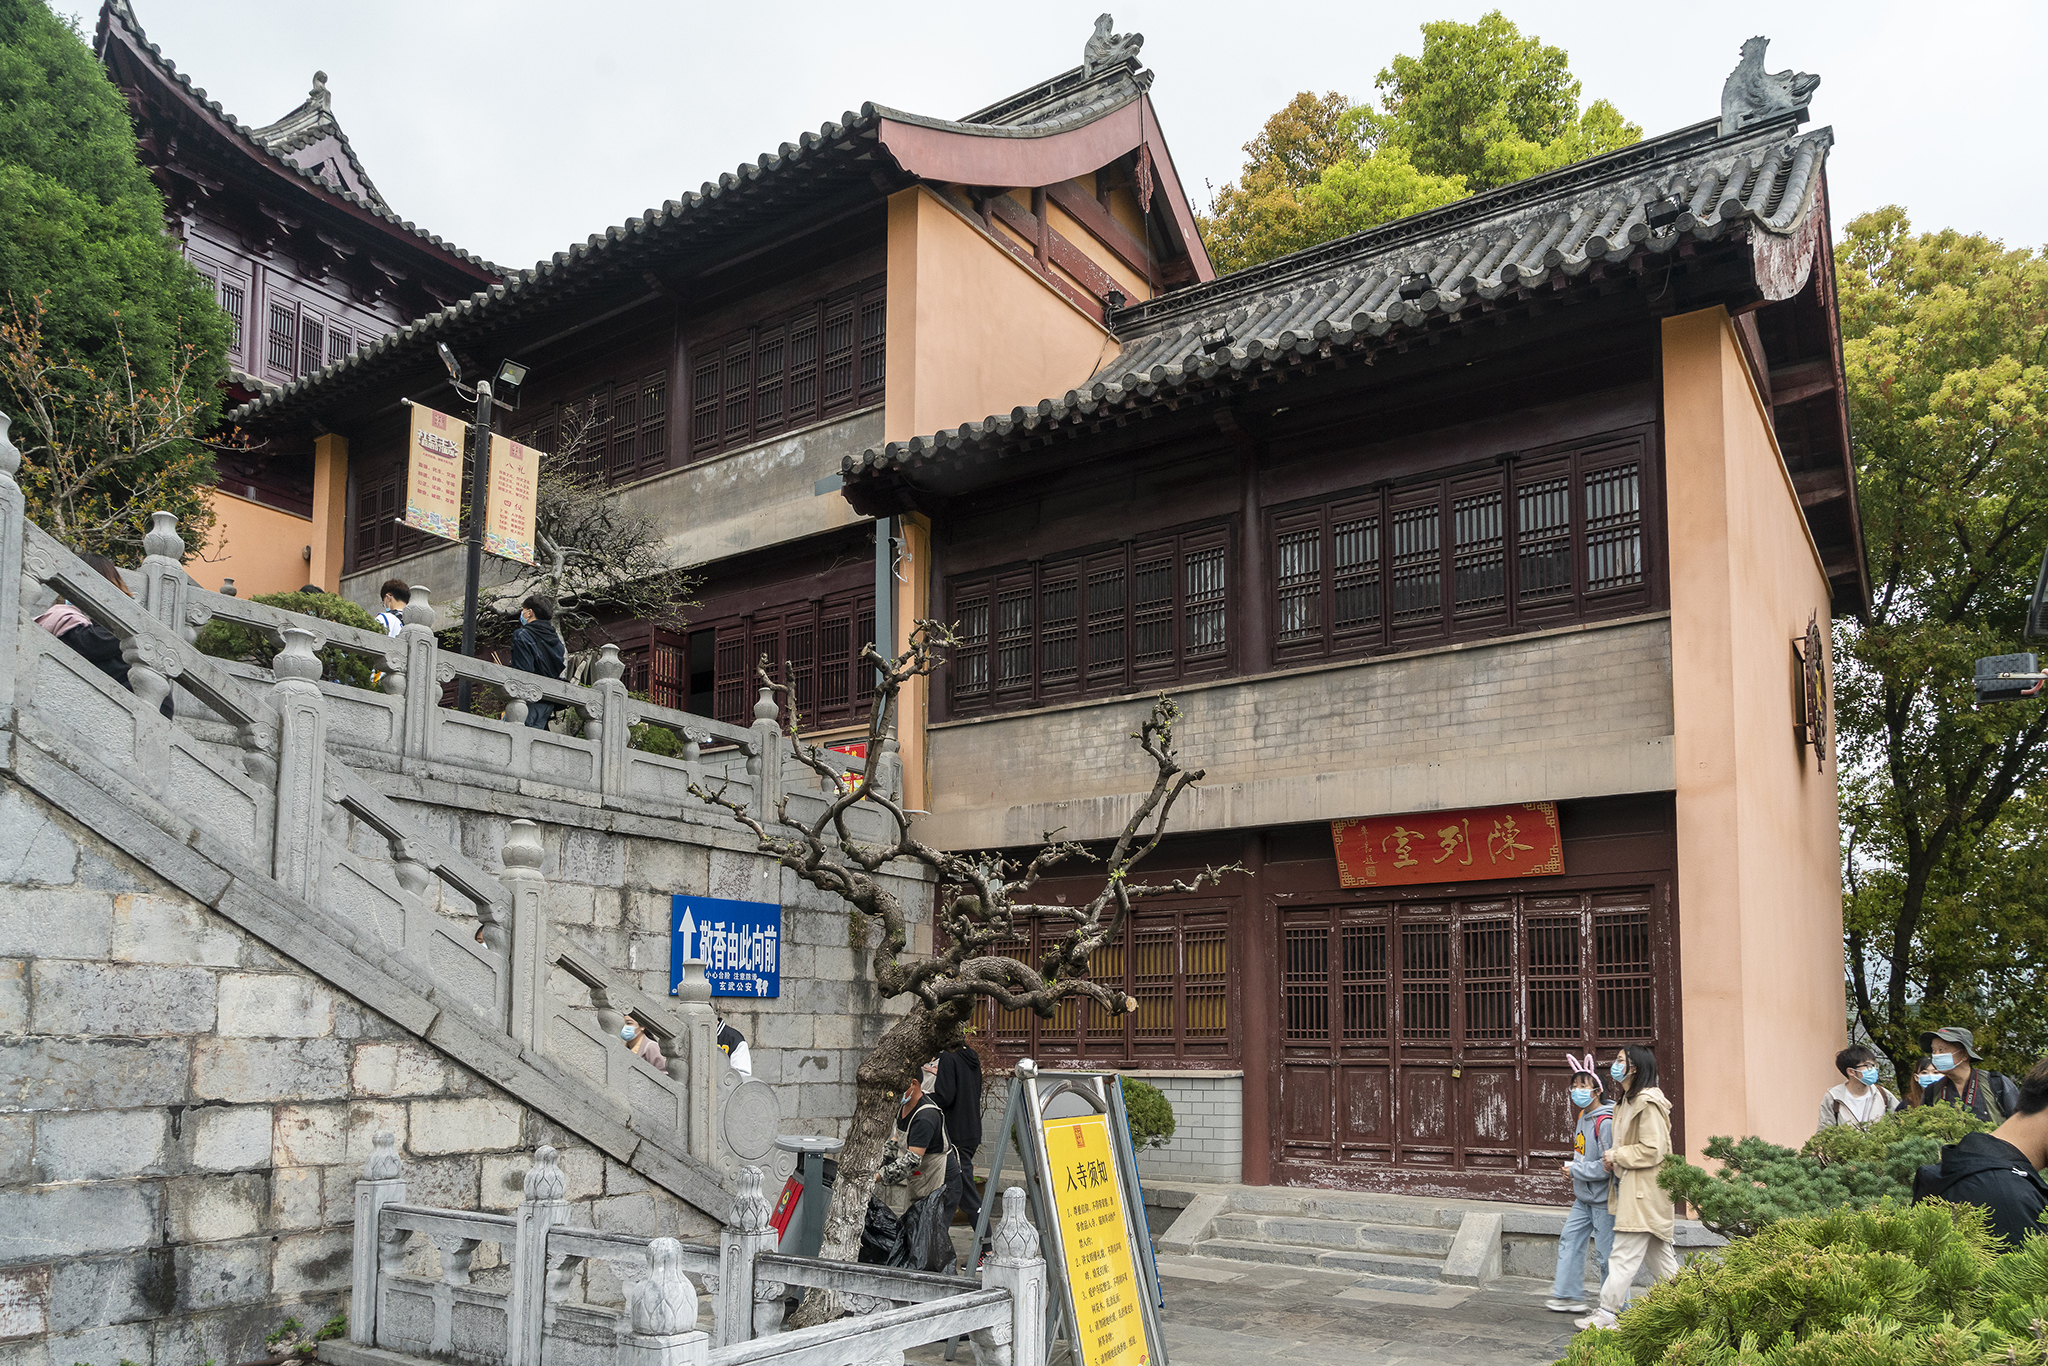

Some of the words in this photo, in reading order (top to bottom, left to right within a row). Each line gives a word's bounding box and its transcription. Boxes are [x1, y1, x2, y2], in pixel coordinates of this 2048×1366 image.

[417, 429, 459, 453] 社会主义
[699, 920, 777, 973] 敬香由此向前
[705, 971, 731, 980] 小心台阶
[733, 972, 758, 981] 注意防滑
[719, 981, 752, 992] 玄武公安
[1065, 1159, 1108, 1193] 入寺须知
